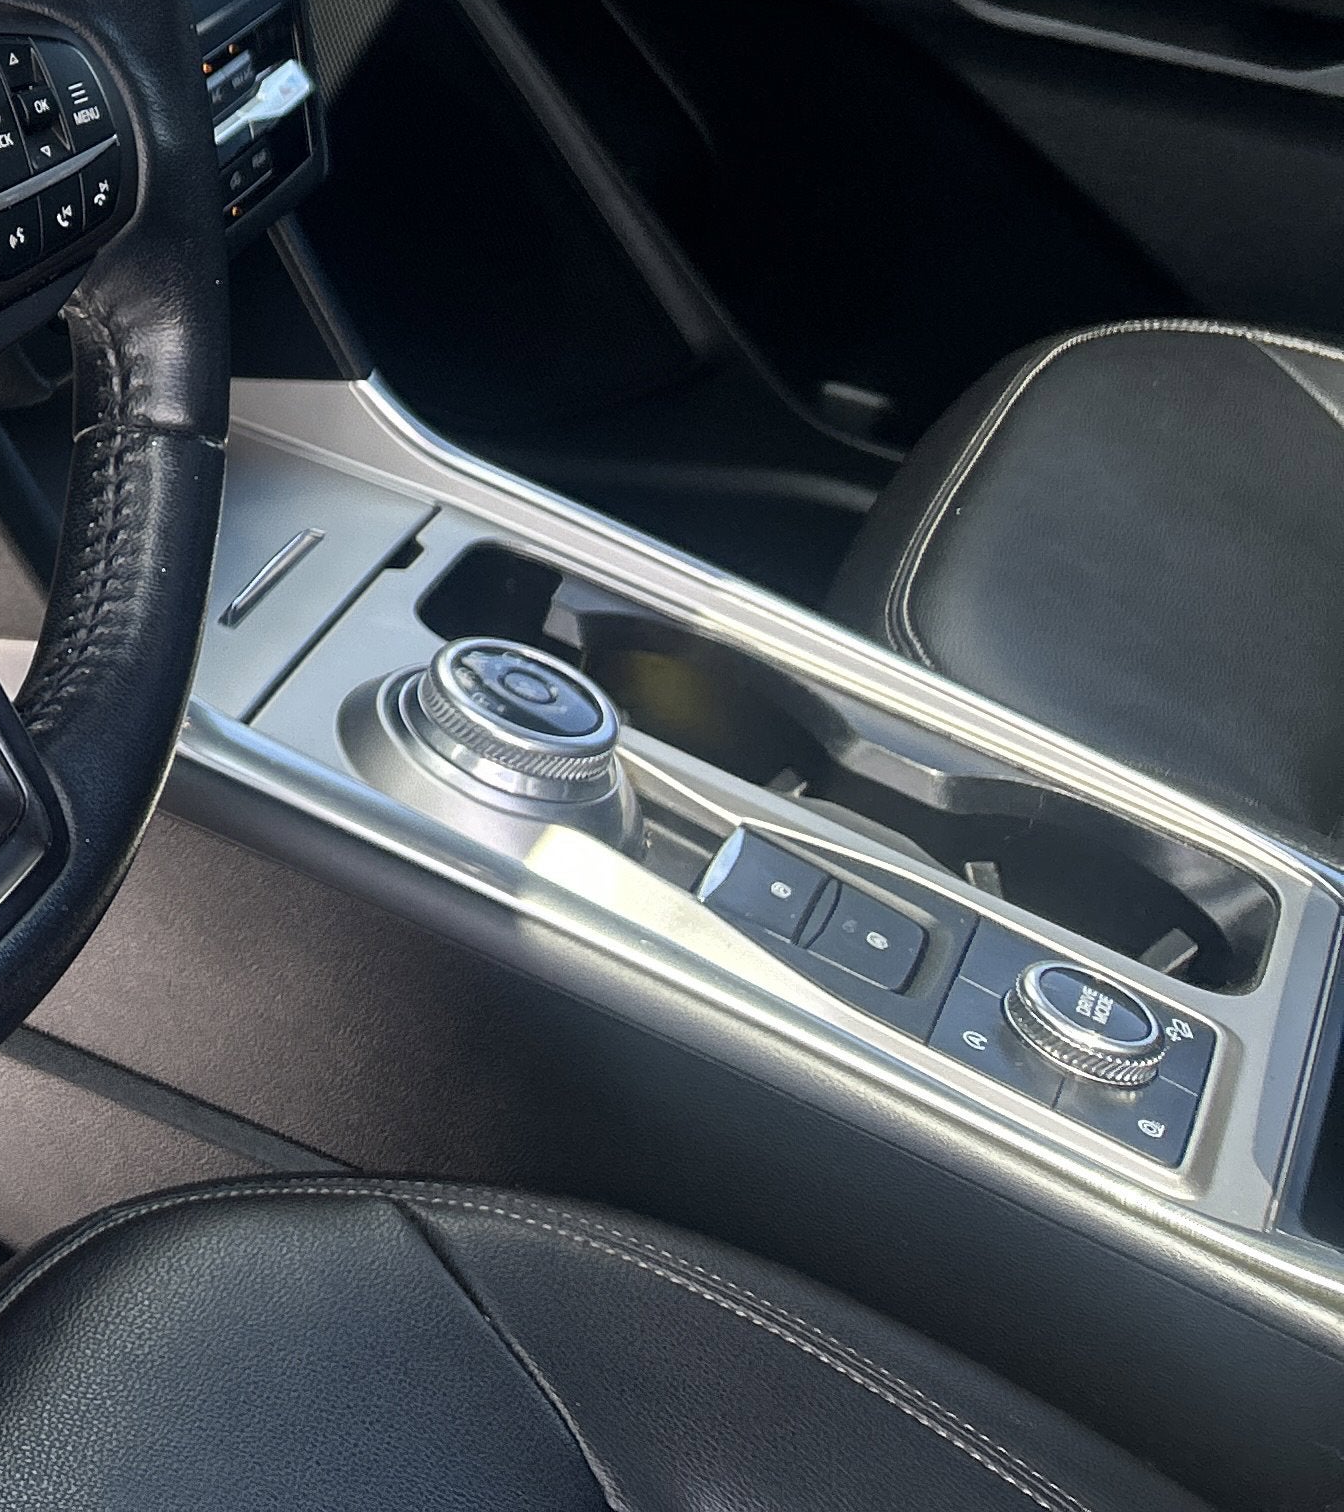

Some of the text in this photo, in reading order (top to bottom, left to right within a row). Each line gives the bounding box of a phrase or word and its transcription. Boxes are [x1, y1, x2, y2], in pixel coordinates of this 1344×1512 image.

[33, 98, 50, 114] OK
[72, 105, 100, 126] MENU
[1075, 985, 1098, 1018] DRIVE
[1092, 993, 1114, 1025] MODE
